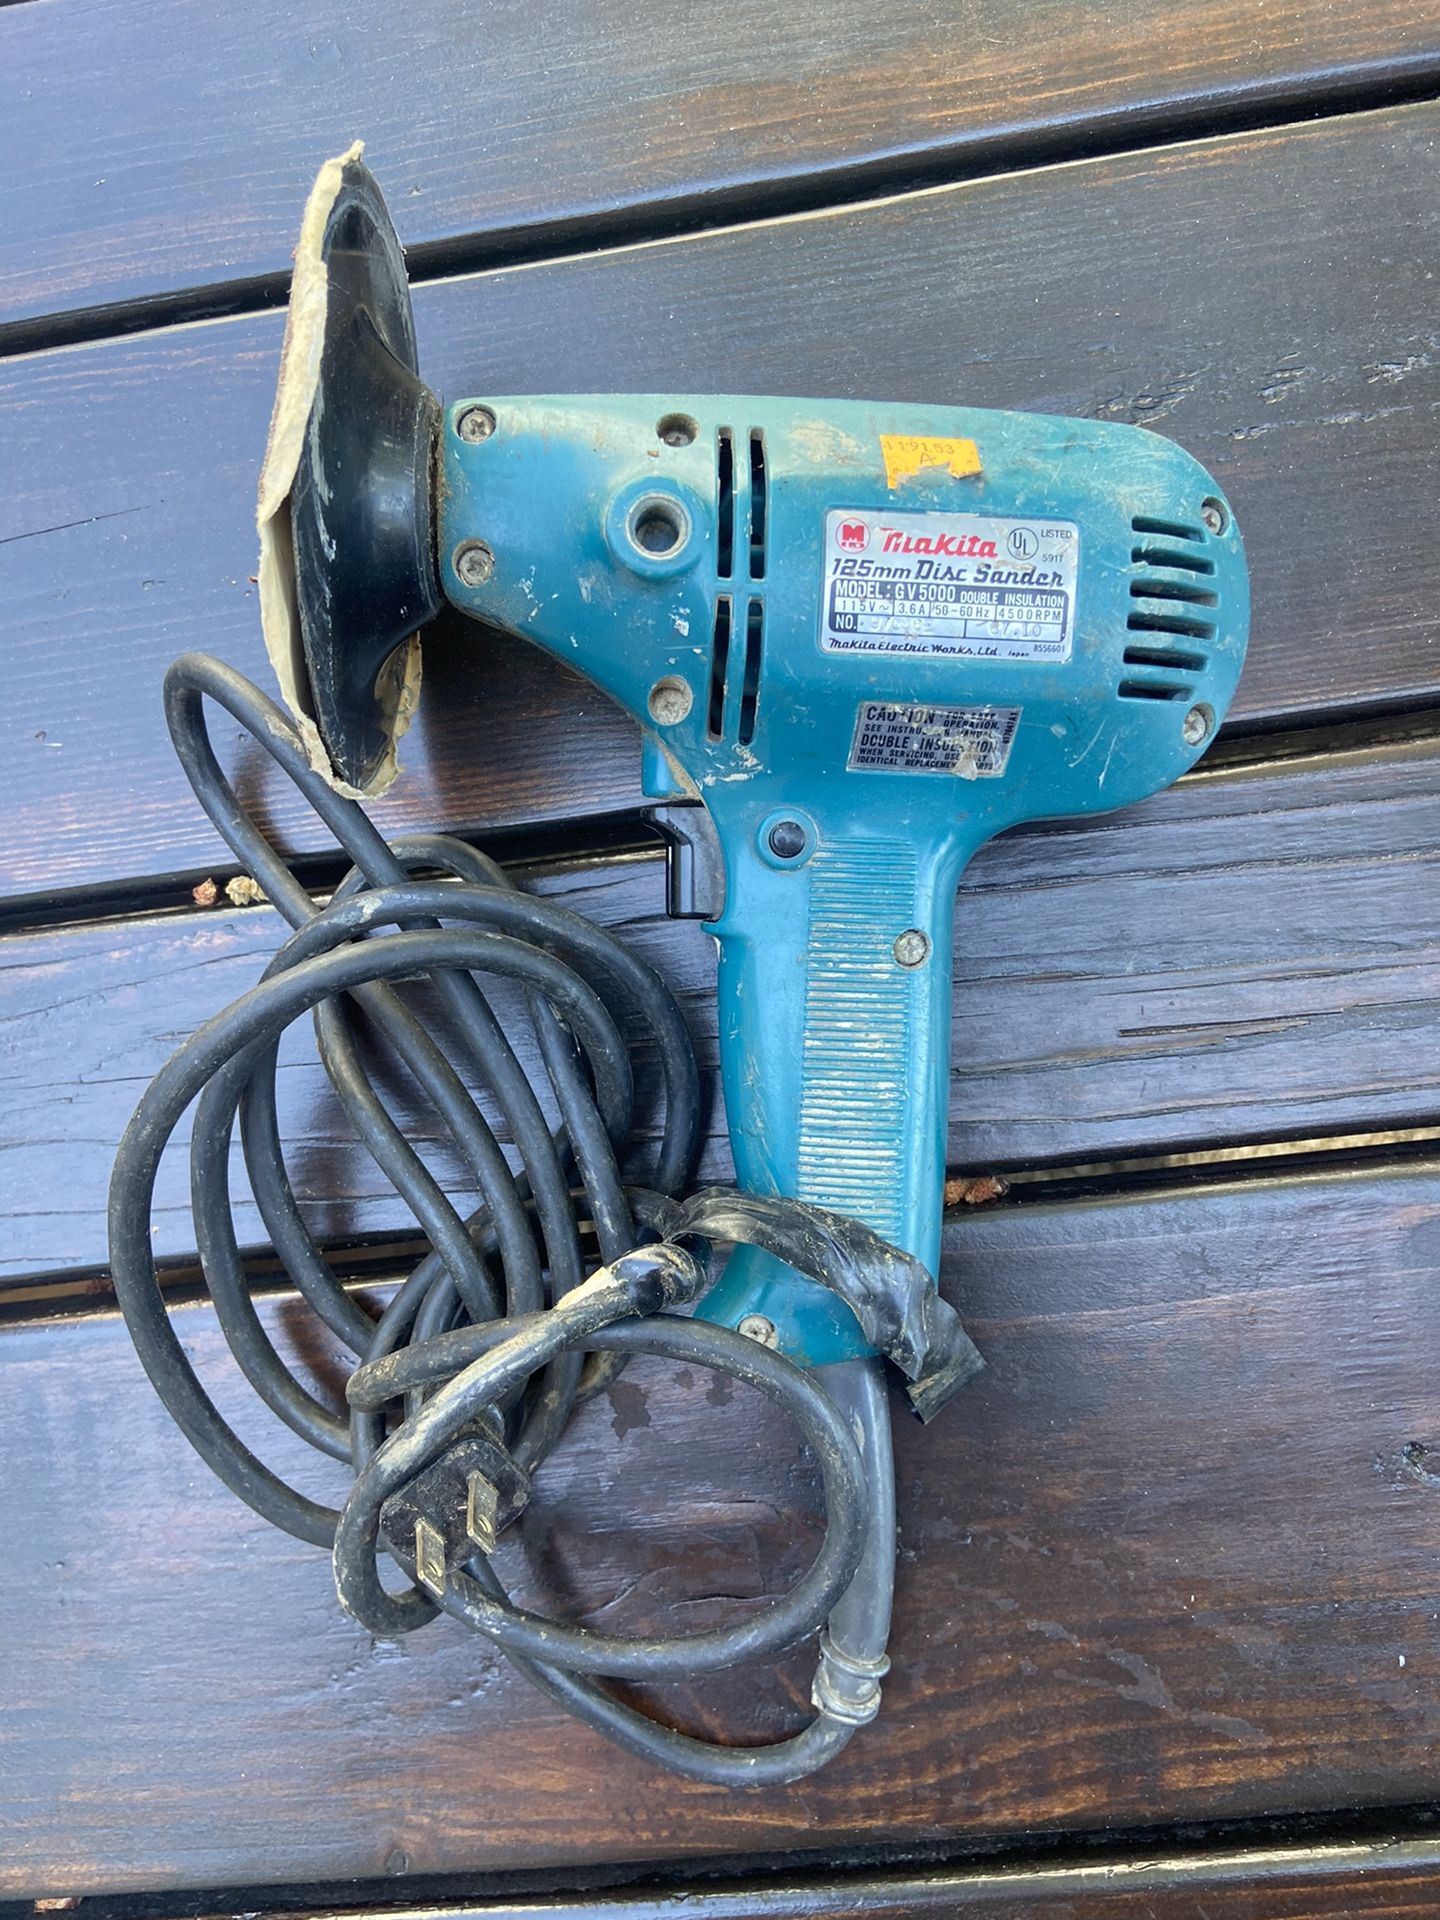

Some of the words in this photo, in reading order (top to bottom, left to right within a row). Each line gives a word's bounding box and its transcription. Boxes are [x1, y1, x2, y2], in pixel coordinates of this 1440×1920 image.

[880, 526, 998, 559] Makita
[1040, 528, 1073, 539] LISTED
[832, 558, 916, 580] 125mm
[914, 559, 967, 581] Disc
[973, 563, 1065, 587] Sander
[895, 585, 956, 602] GV5000
[960, 591, 999, 605] DOUBLE
[1004, 593, 1066, 608] INSULATION
[898, 603, 926, 615] 3.6A
[835, 614, 857, 629] NO.
[828, 637, 876, 650] Makita
[875, 640, 929, 653] Electric
[866, 706, 935, 724] CAUION
[864, 723, 882, 732] SEE
[861, 734, 910, 748] DOUBLE
[859, 748, 884, 756] WHEN
[944, 753, 960, 761] USE
[857, 756, 898, 765] IDENTICAL
[905, 759, 960, 769] REPLACEMEN
